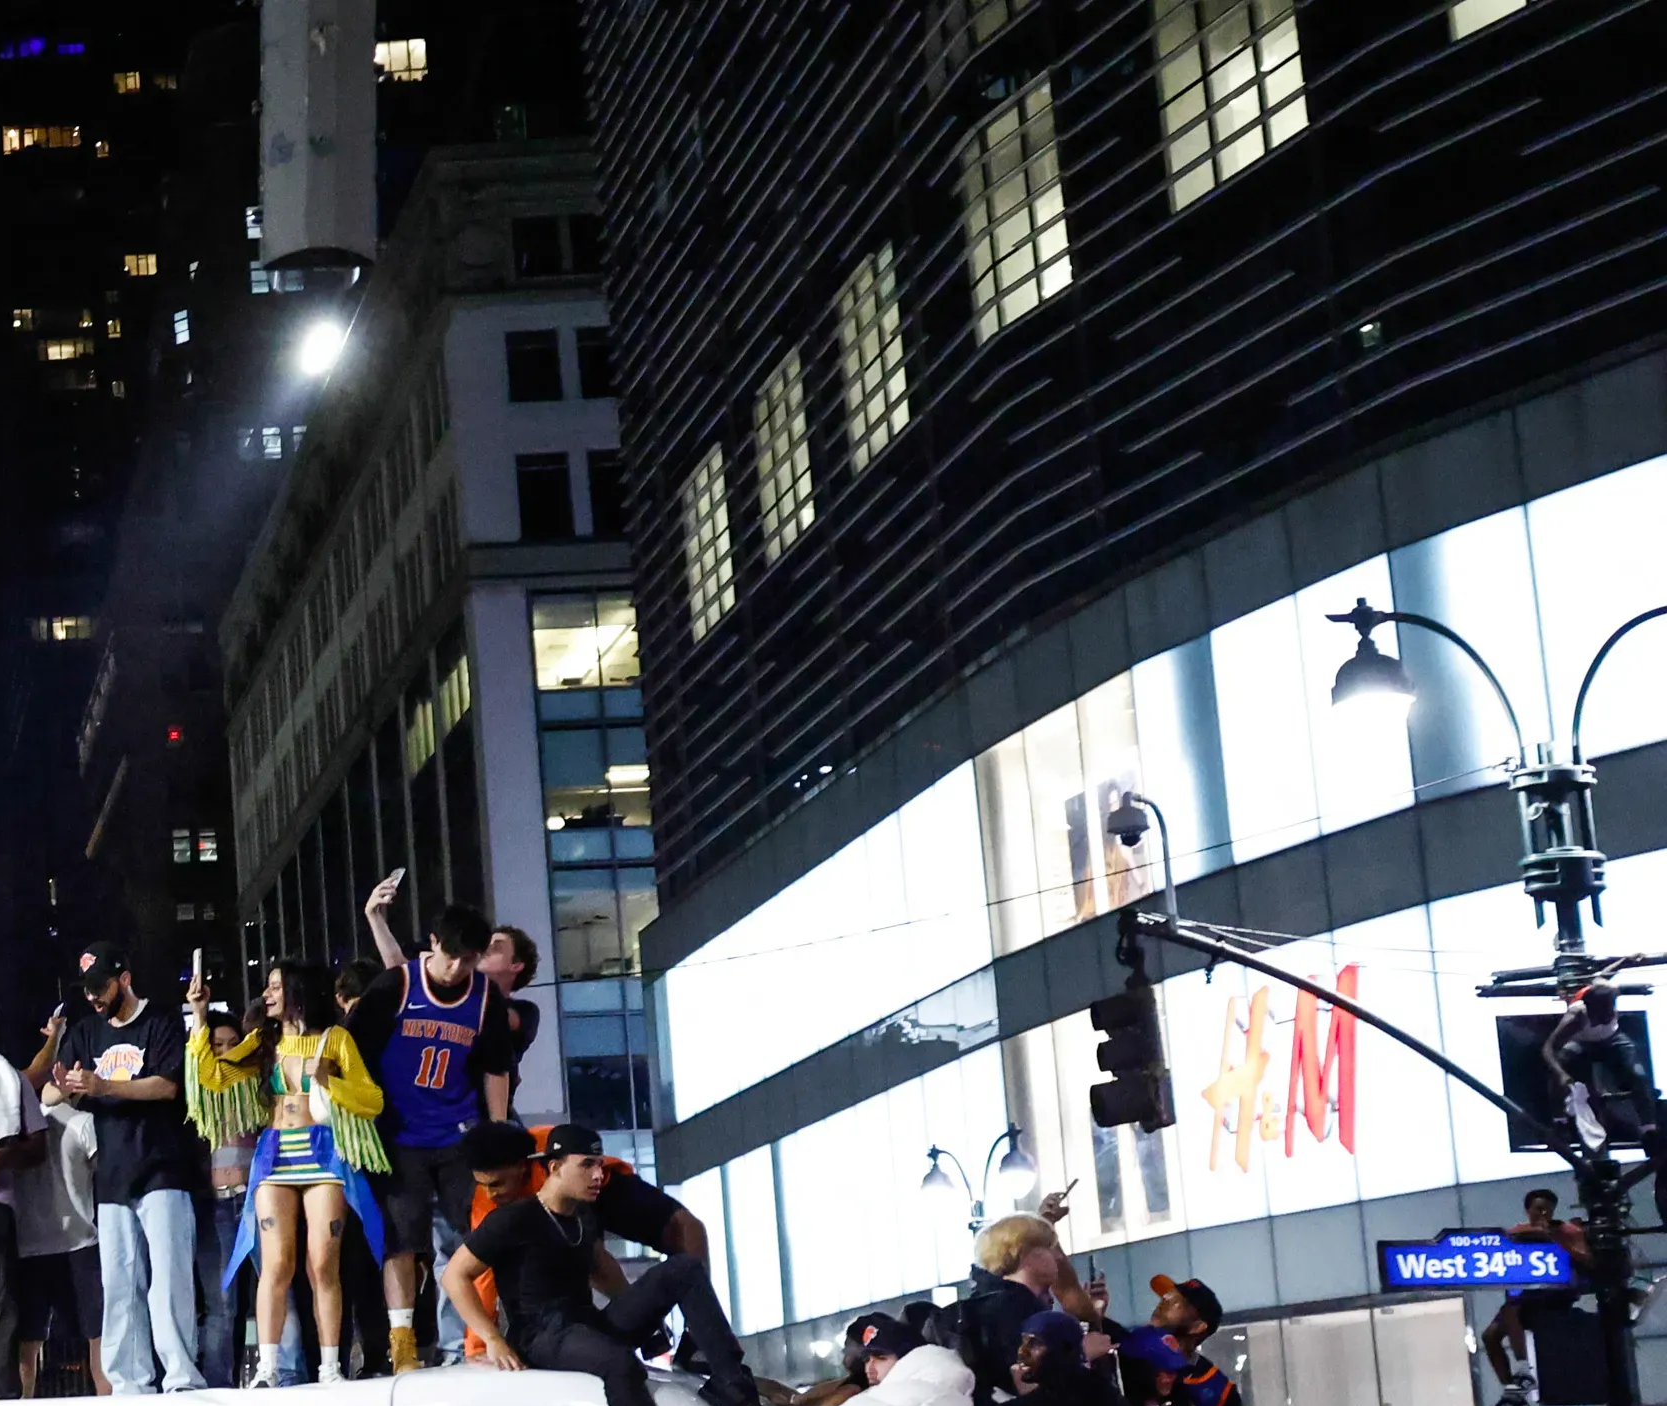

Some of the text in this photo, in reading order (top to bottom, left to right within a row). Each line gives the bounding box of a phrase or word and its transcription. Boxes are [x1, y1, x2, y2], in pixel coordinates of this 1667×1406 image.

[414, 1045, 451, 1089] 11
[1201, 962, 1359, 1174] H&M
[1481, 1235, 1501, 1246] 172
[1396, 1249, 1559, 1279] West 34th St
